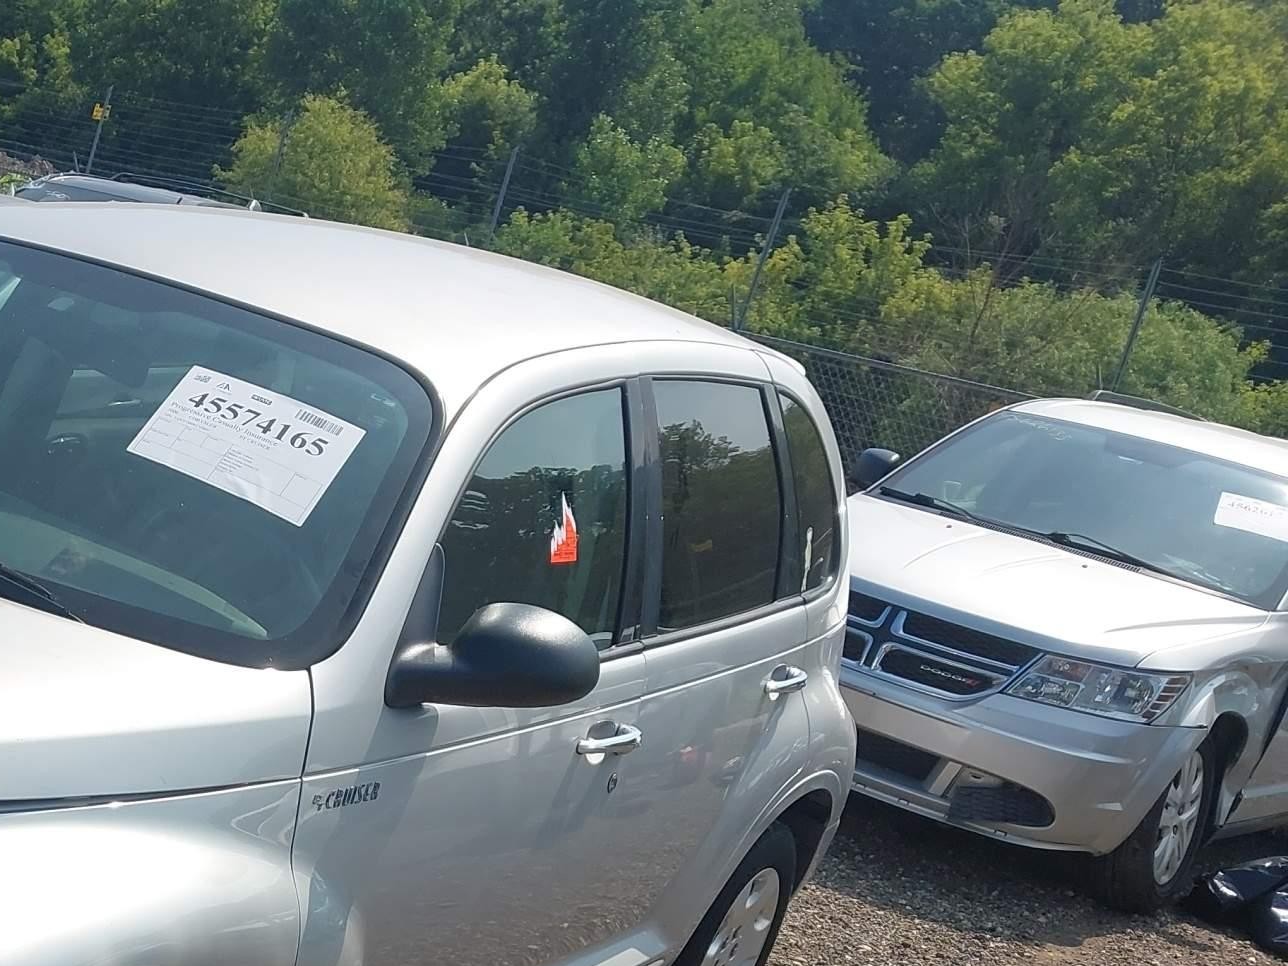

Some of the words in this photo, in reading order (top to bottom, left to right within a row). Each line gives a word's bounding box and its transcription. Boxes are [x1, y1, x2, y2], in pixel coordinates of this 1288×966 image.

[171, 400, 212, 420] Progressive
[243, 427, 279, 446] Insurance
[188, 393, 329, 456] 45574165
[325, 781, 380, 809] CRUISER
